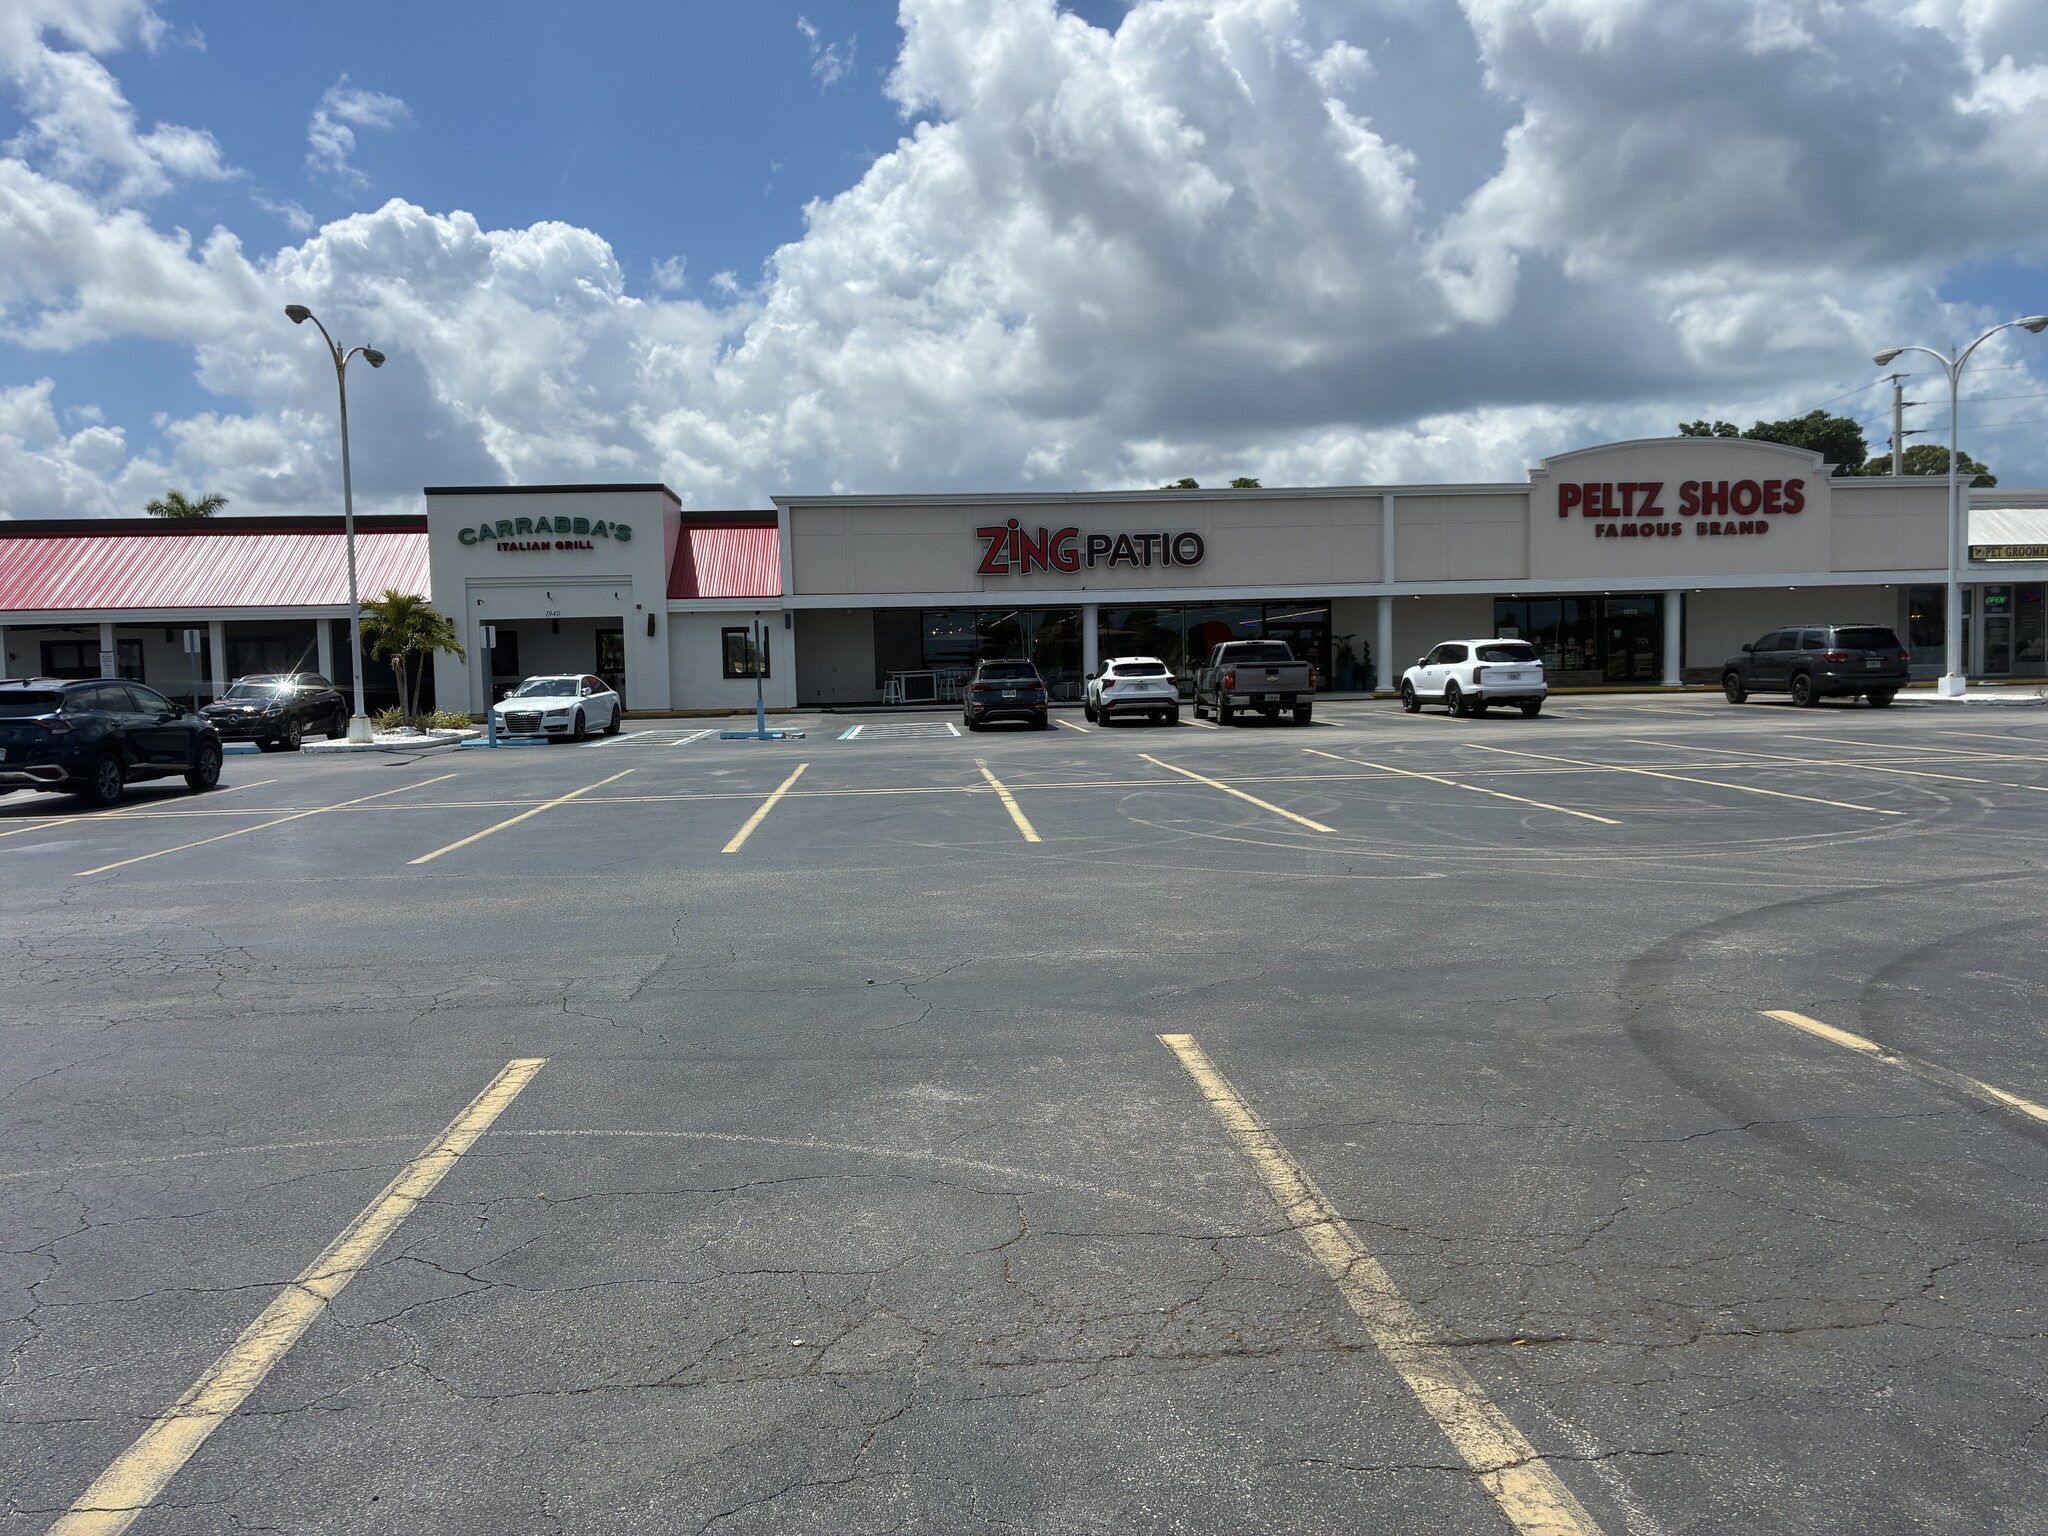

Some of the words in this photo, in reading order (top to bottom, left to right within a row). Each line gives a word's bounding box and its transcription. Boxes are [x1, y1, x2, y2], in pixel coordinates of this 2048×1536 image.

[1558, 482, 1665, 517] PELTZ
[1679, 478, 1805, 516] SHOES
[457, 516, 632, 546] CARRABBA'S
[1595, 522, 1683, 538] FAMOUS
[1696, 520, 1770, 536] BRAND
[497, 541, 550, 552] ITALIAN
[555, 540, 594, 550] GRILL
[1085, 531, 1206, 569] PATIO
[1985, 547, 2003, 557] PET
[1985, 595, 2007, 604] OPEN
